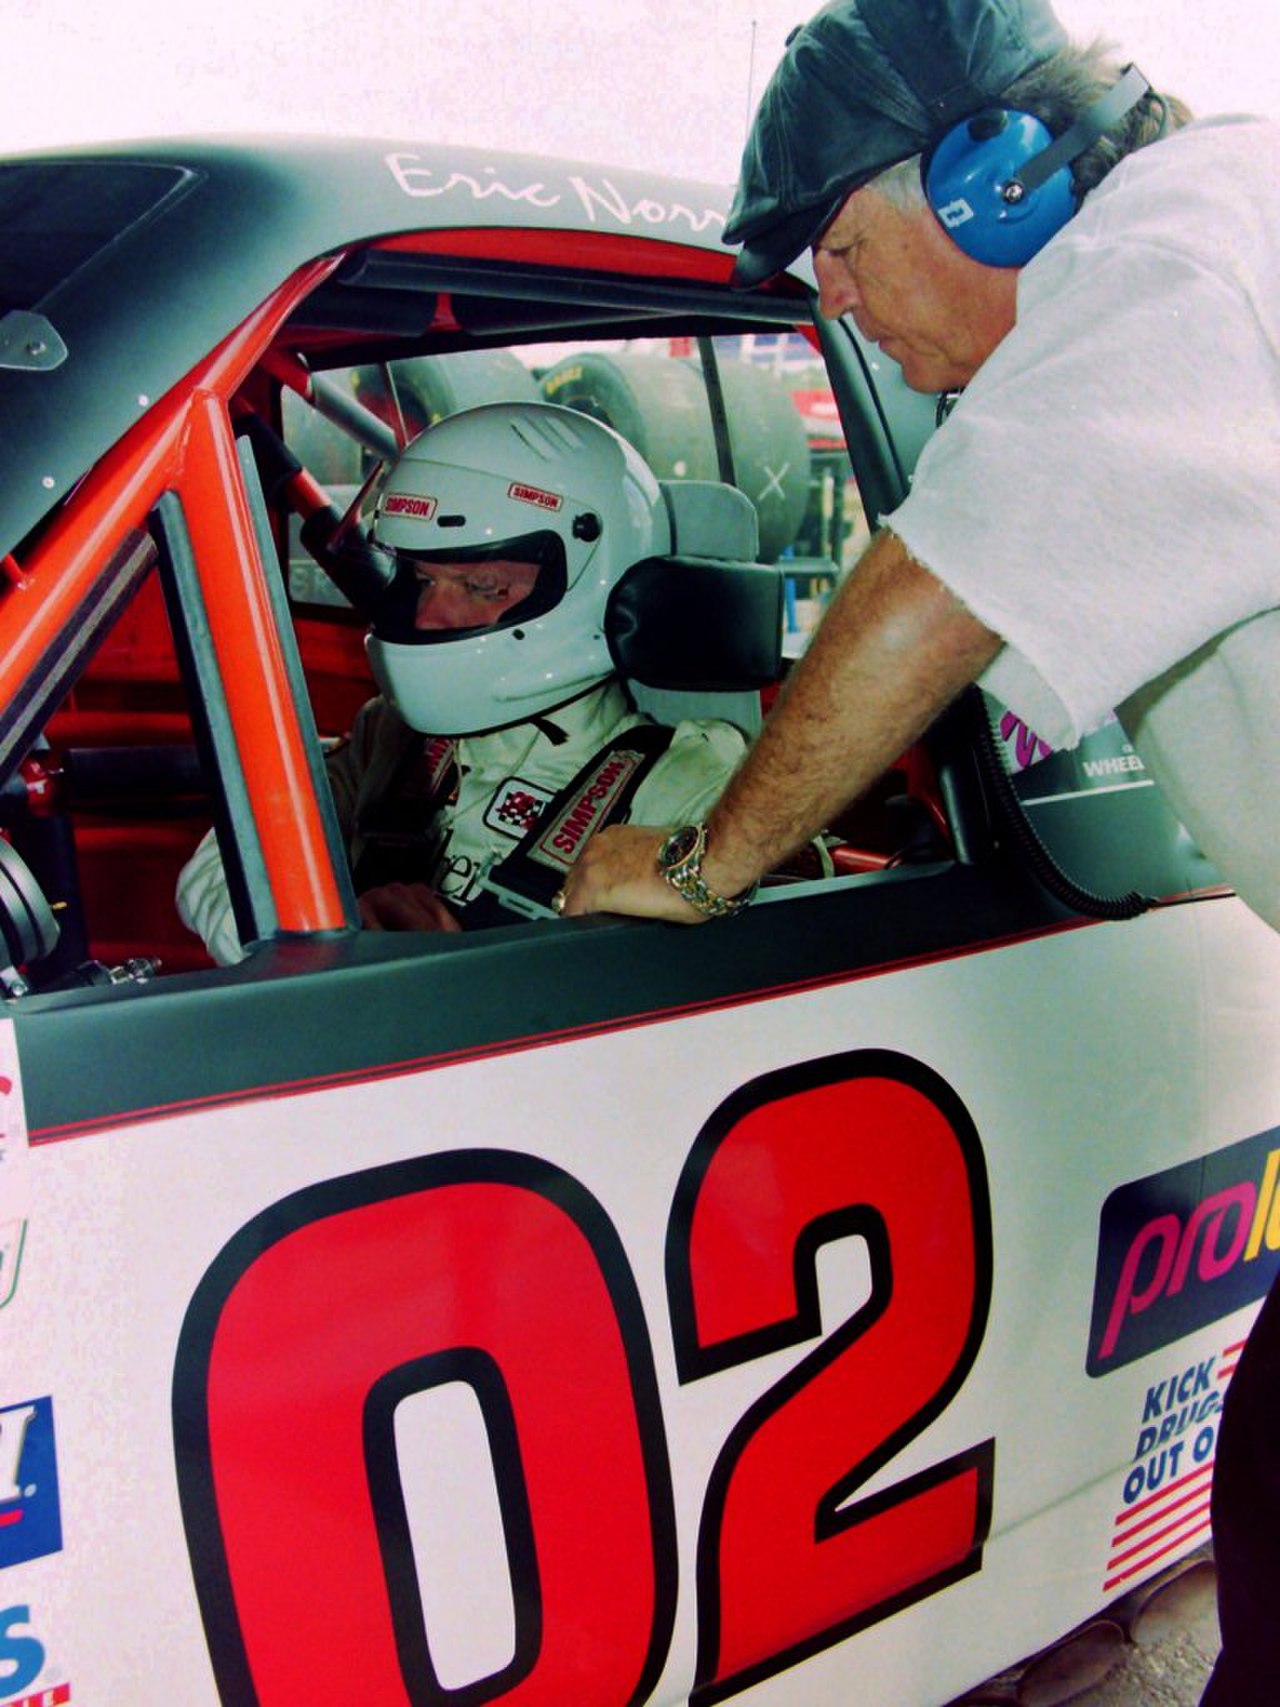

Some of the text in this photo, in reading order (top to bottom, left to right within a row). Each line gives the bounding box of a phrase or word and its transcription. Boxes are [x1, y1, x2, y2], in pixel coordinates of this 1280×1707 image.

[384, 152, 725, 232] Eric Norr
[384, 496, 431, 517] SIMPSON
[512, 486, 559, 509] SIMPSON
[552, 760, 626, 854] SIMPSON
[171, 1048, 996, 1707] 02
[1141, 1355, 1217, 1424] KICK
[1132, 1390, 1224, 1463] DRUG
[1123, 1440, 1185, 1504] OUT
